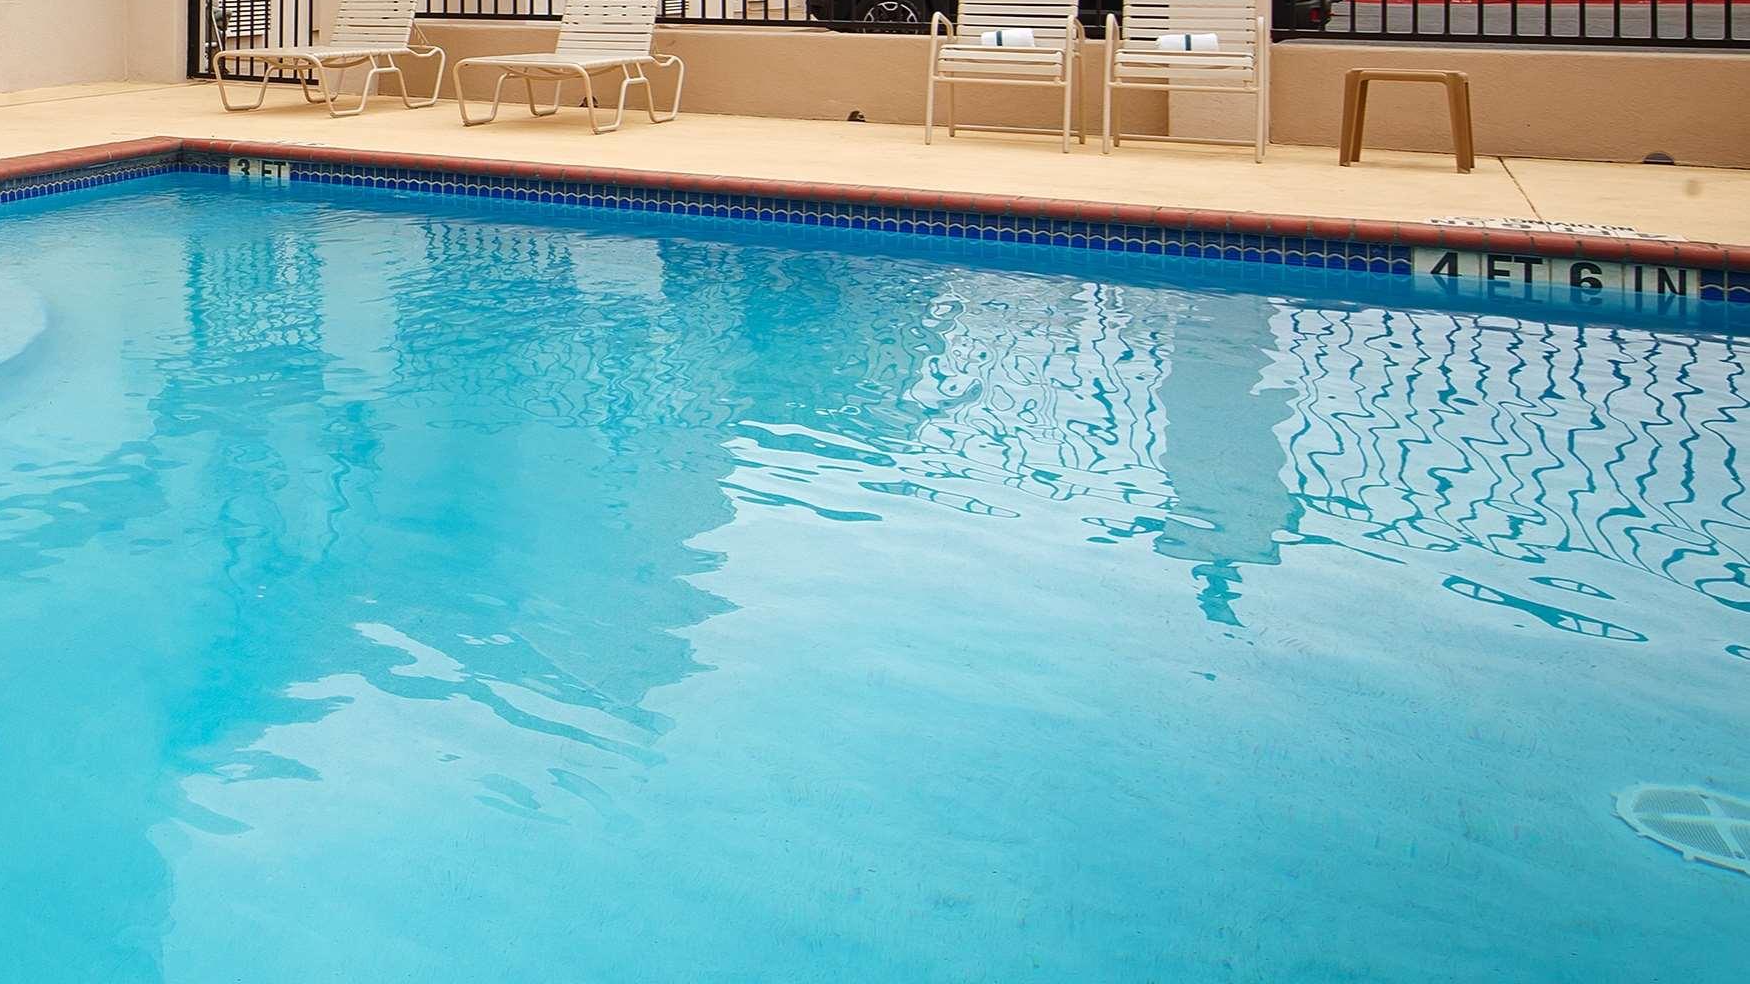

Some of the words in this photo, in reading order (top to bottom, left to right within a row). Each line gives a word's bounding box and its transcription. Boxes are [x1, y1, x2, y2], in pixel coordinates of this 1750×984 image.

[237, 159, 251, 176] 3
[261, 160, 287, 177] FT
[1430, 251, 1462, 277] 4
[1487, 254, 1543, 283] FT
[1569, 260, 1603, 289] 6
[1634, 265, 1687, 296] IN
